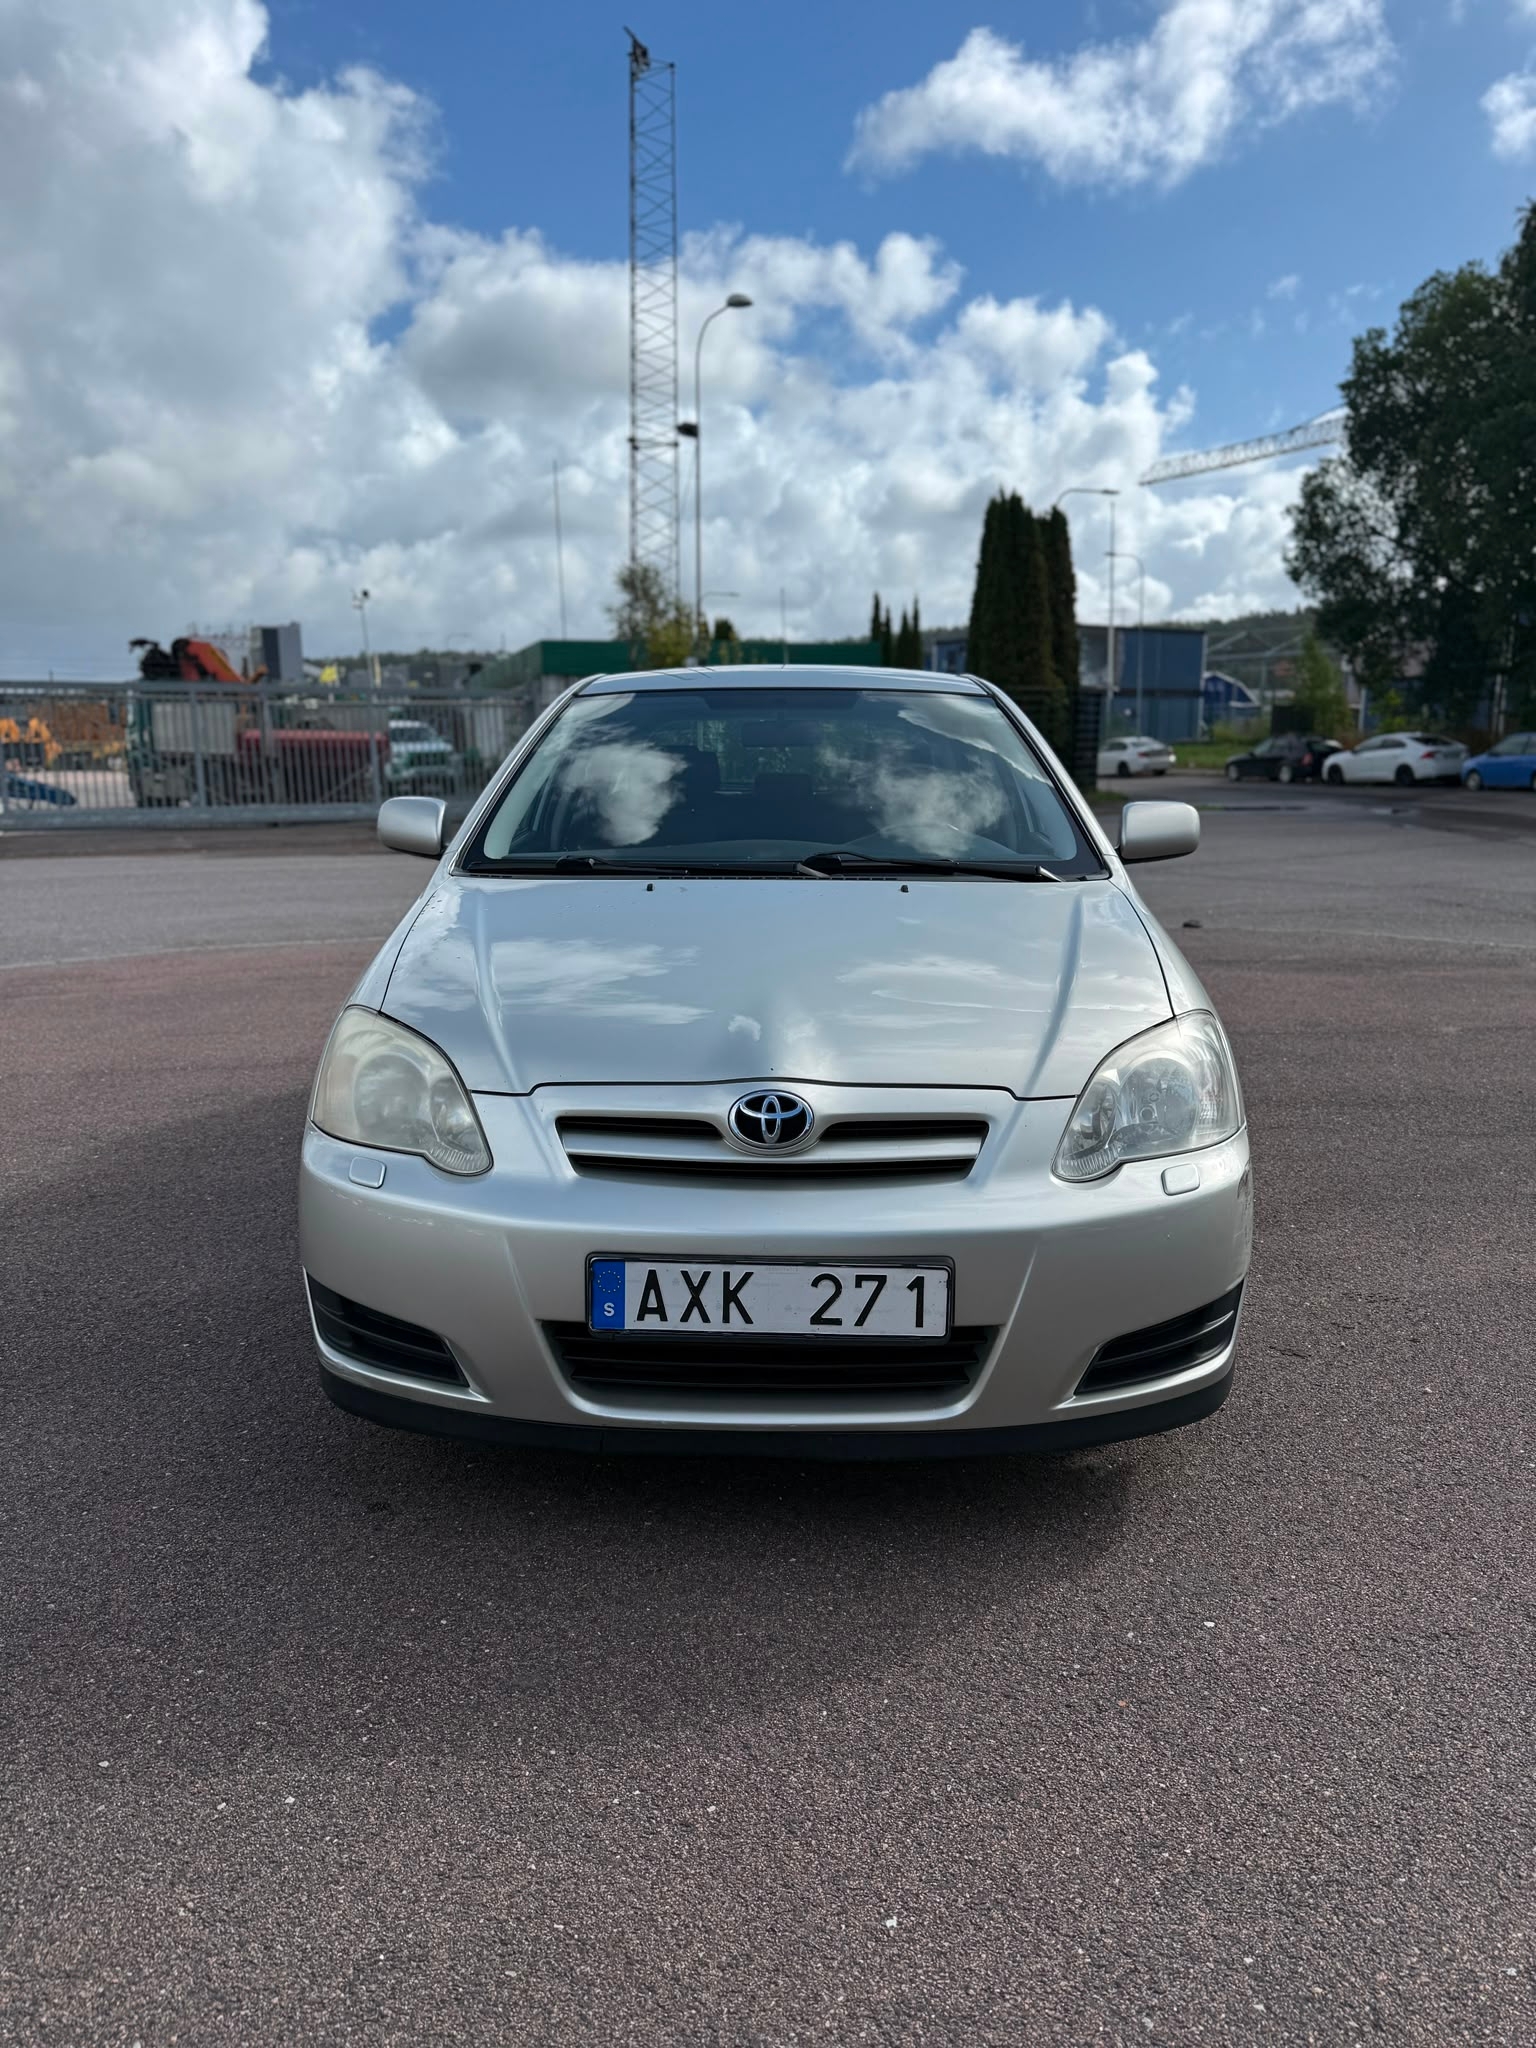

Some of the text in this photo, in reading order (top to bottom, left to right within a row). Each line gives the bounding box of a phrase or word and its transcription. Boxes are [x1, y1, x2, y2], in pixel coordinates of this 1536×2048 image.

[603, 1302, 615, 1317] S
[636, 1268, 925, 1329] AXK 271
